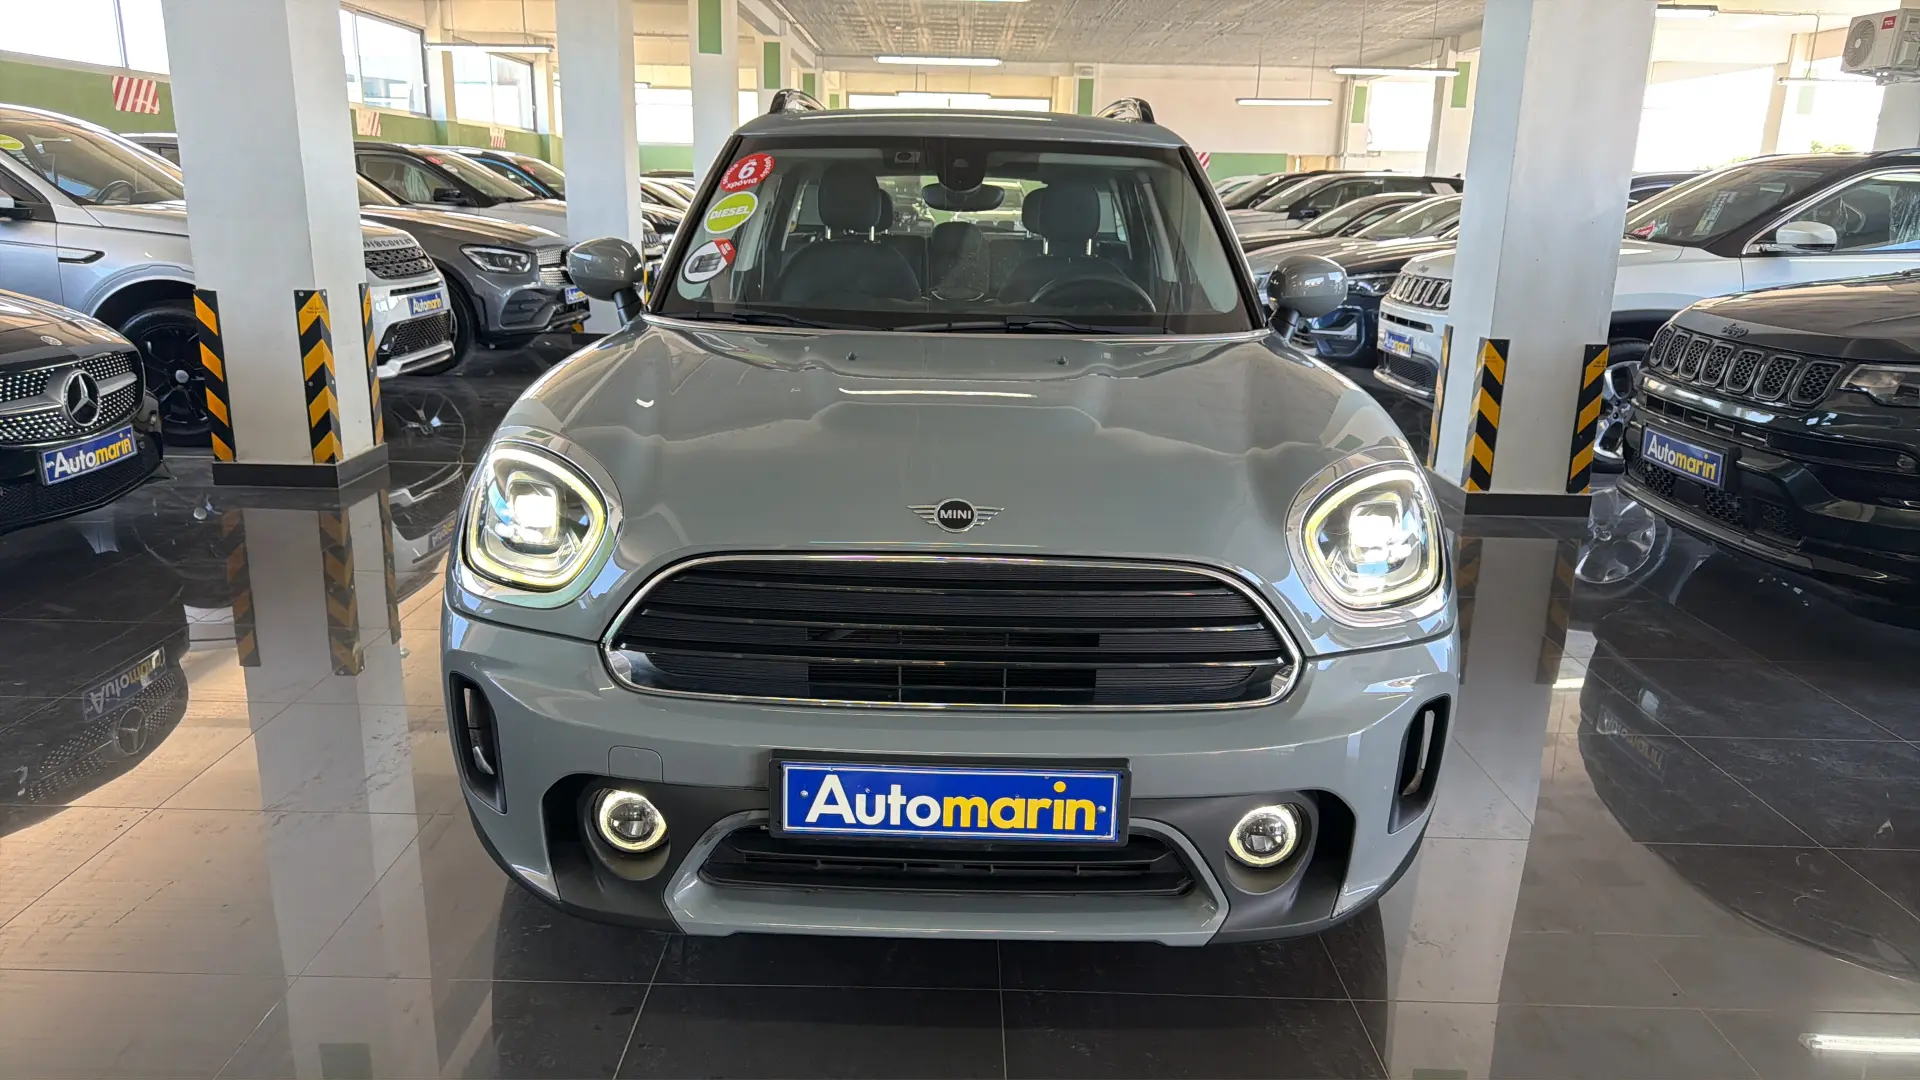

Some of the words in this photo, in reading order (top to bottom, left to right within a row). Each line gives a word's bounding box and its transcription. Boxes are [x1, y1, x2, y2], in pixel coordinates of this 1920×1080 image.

[738, 161, 757, 180] 6
[710, 205, 750, 220] DIESEL
[54, 432, 132, 478] Automarin
[1647, 434, 1717, 480] Automarin
[940, 509, 972, 519] MINI
[804, 774, 1096, 831] Automarin
